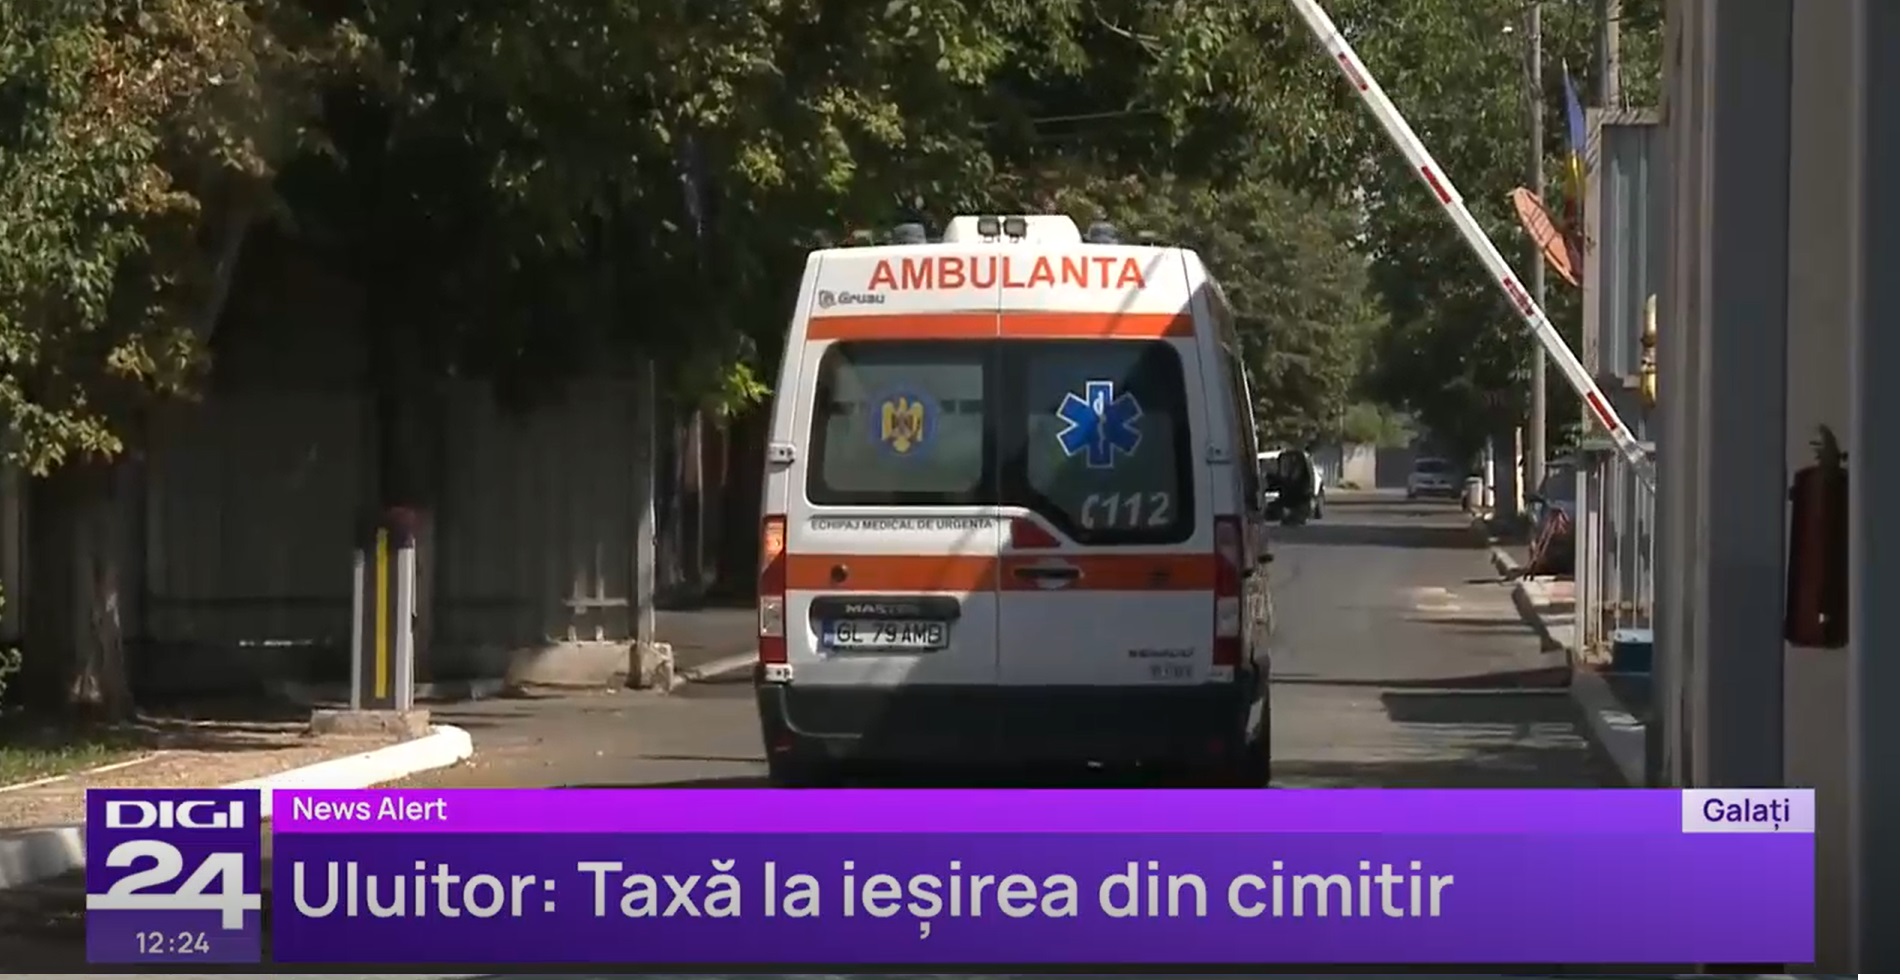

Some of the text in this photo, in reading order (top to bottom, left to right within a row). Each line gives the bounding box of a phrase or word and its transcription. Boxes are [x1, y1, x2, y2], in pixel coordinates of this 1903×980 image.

[867, 256, 1146, 291] AMBULANTA
[811, 518, 993, 531] ECHIPAJ MEDICAL DE URGENTA
[837, 622, 863, 643] GL
[873, 622, 897, 643] 79
[902, 623, 942, 644] AMB
